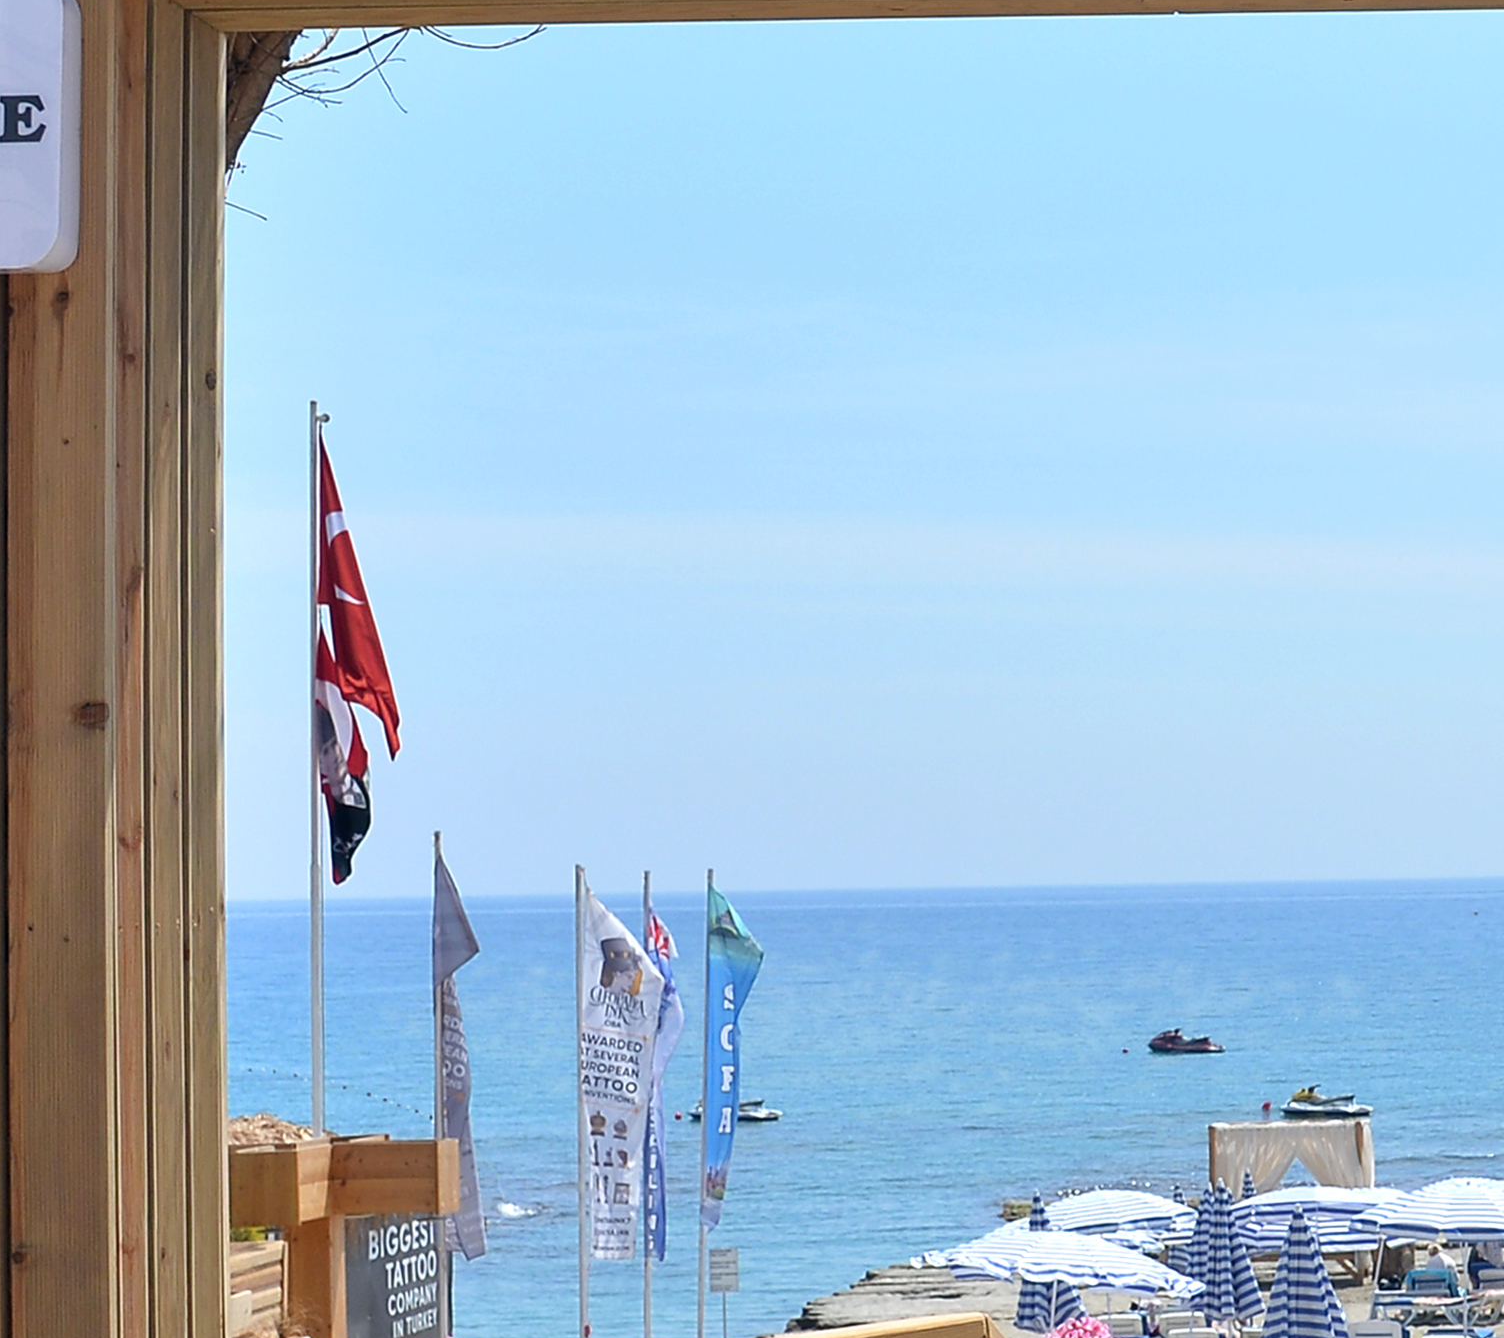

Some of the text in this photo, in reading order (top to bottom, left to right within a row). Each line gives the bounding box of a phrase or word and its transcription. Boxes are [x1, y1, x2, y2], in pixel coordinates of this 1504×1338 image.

[581, 1061, 640, 1079] UROPEAN
[582, 1074, 638, 1094] ATTOO
[385, 1249, 437, 1290] TATTOO
[387, 1282, 438, 1317] COMPANY
[406, 1306, 438, 1335] TURKEY
